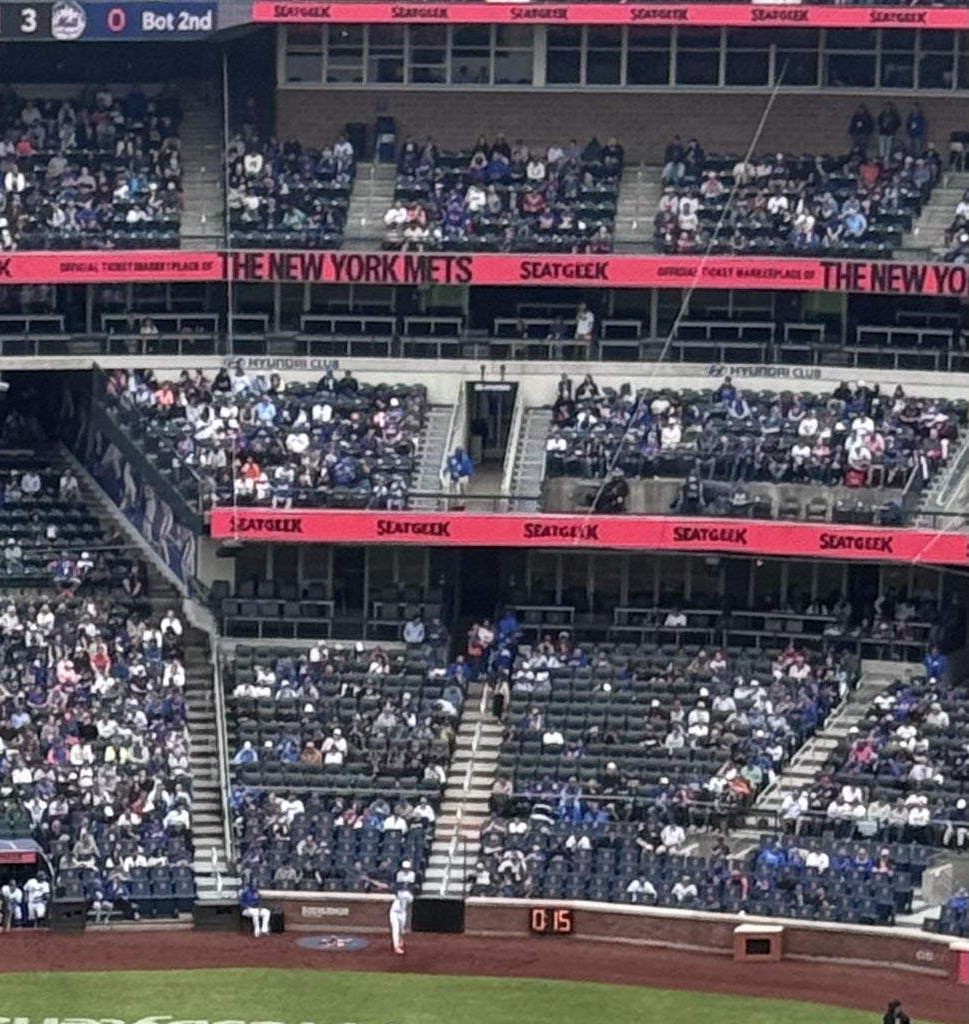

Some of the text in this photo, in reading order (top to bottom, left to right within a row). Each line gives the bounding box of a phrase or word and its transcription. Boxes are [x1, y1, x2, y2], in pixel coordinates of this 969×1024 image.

[21, 8, 37, 33] 3
[107, 8, 126, 32] 0
[142, 11, 212, 31] Bot 2nd
[217, 252, 472, 283] THE NEW YORK METS
[520, 261, 609, 280] SEATGEEK
[820, 261, 868, 291] THE
[870, 263, 927, 292] NEW
[310, 359, 339, 369] CLUB
[793, 367, 822, 379] CLUB
[229, 516, 303, 533] SEATGEEK
[377, 519, 450, 537] SEATGEEK
[523, 522, 599, 540] SEATGEEK
[673, 526, 747, 545] SEATGEEK
[819, 533, 893, 553] SEATGEEK
